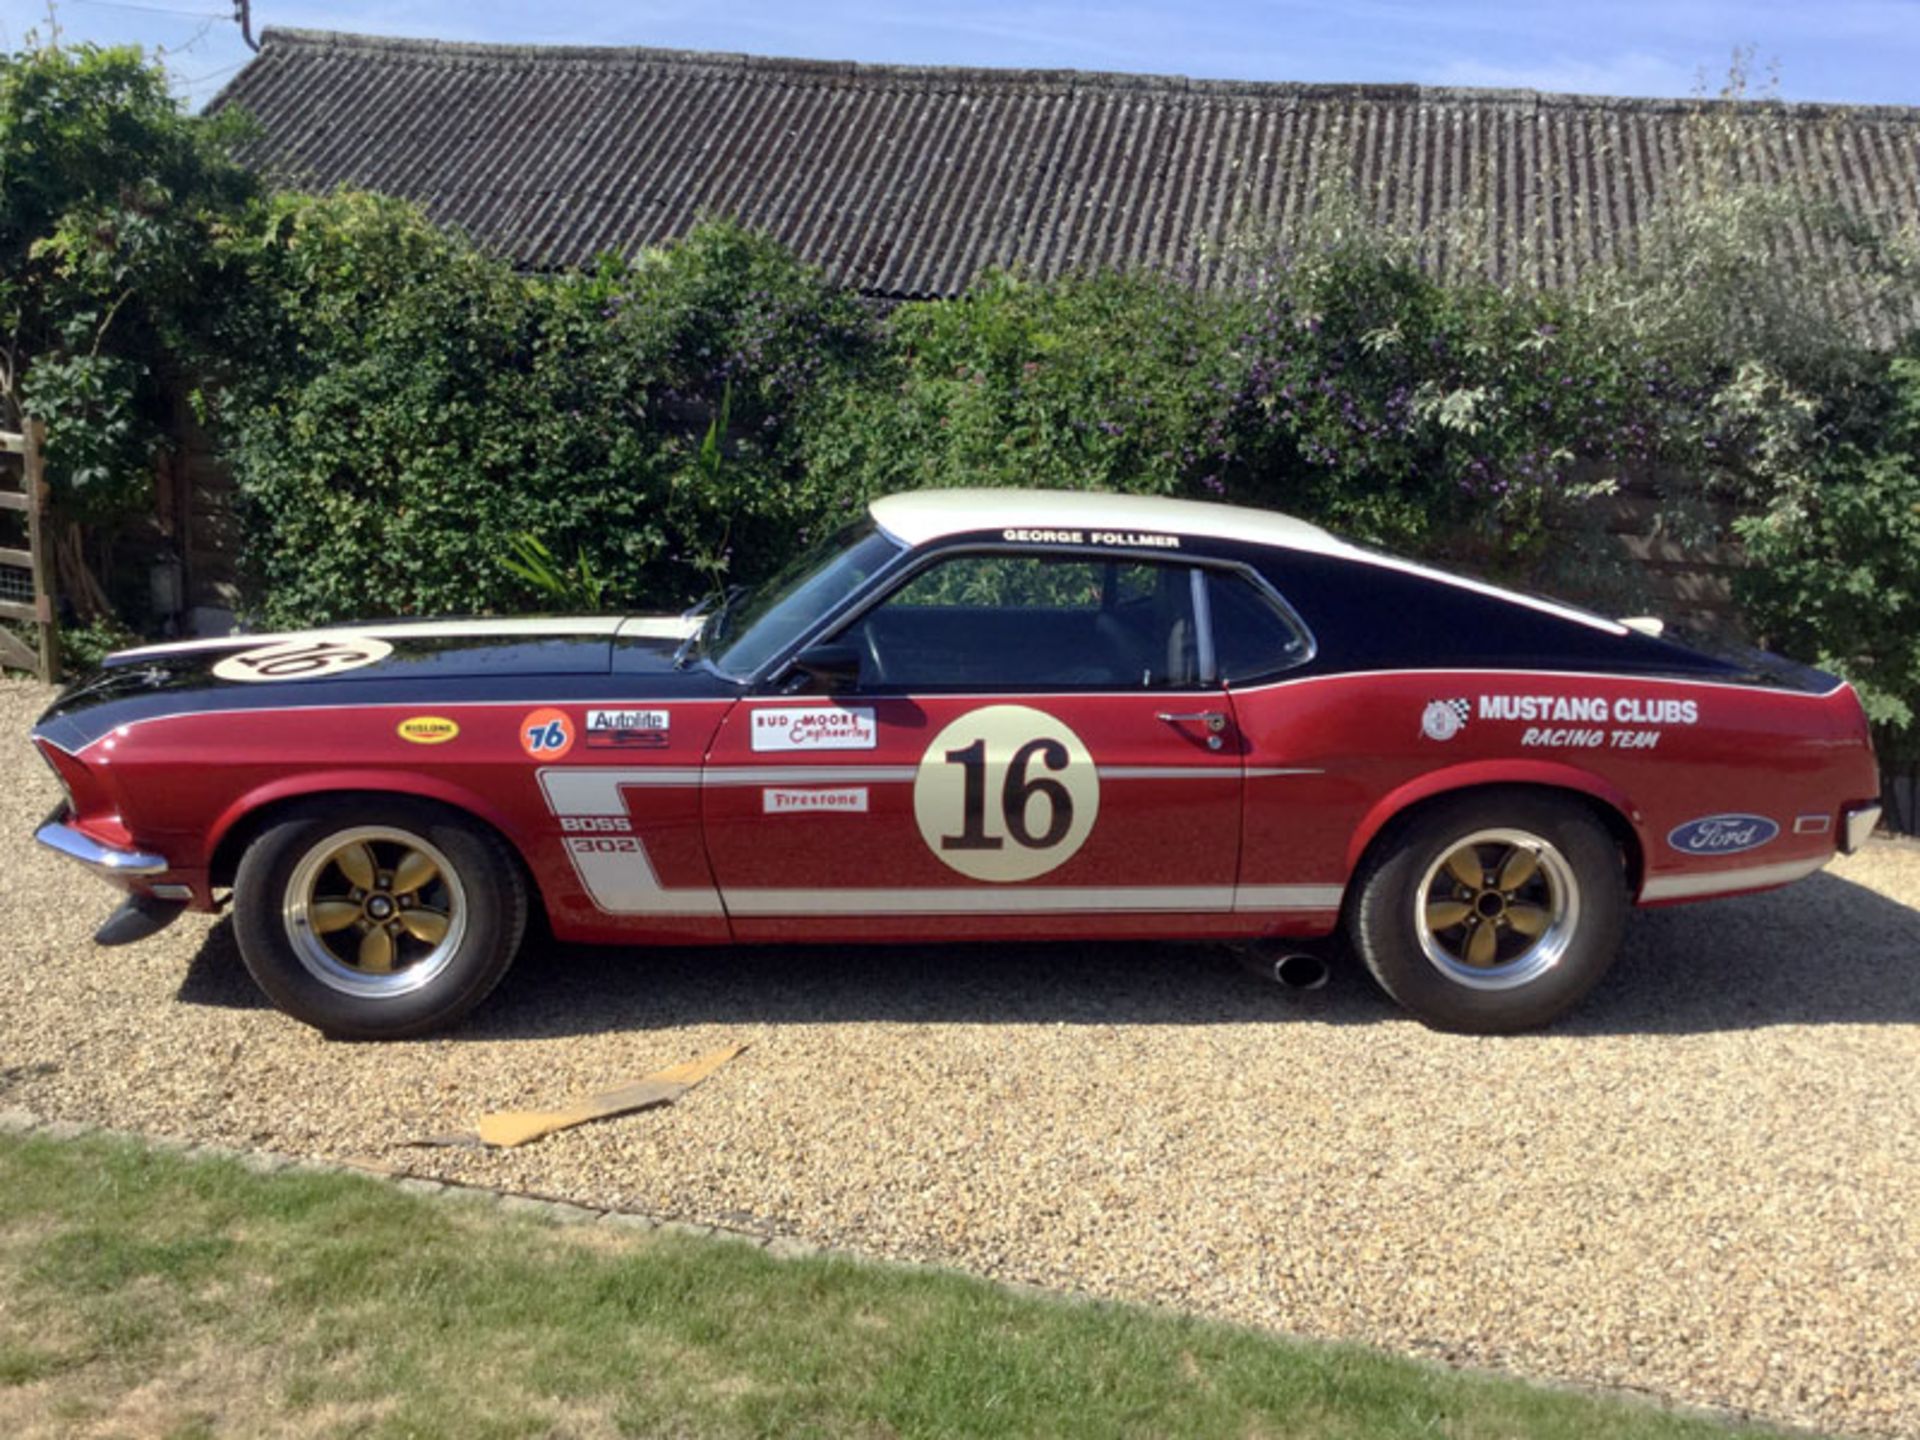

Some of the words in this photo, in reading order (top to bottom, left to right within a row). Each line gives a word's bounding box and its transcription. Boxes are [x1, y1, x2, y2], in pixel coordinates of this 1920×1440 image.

[1003, 529, 1083, 543] GEORGE
[1091, 532, 1180, 547] FOLLMER
[1479, 696, 1608, 722] MUSTANG
[1614, 699, 1698, 724] CLUBS
[594, 712, 662, 729] Autolite
[757, 715, 789, 727] BUD
[801, 714, 858, 726] MOORE
[528, 720, 567, 750] 76
[1521, 728, 1604, 747] RACING
[1611, 731, 1660, 749] TEAM
[774, 793, 858, 807] Firestone
[941, 738, 1074, 850] 16
[560, 818, 633, 832] BOSS
[1689, 820, 1758, 849] Ford
[573, 839, 638, 853] 302
